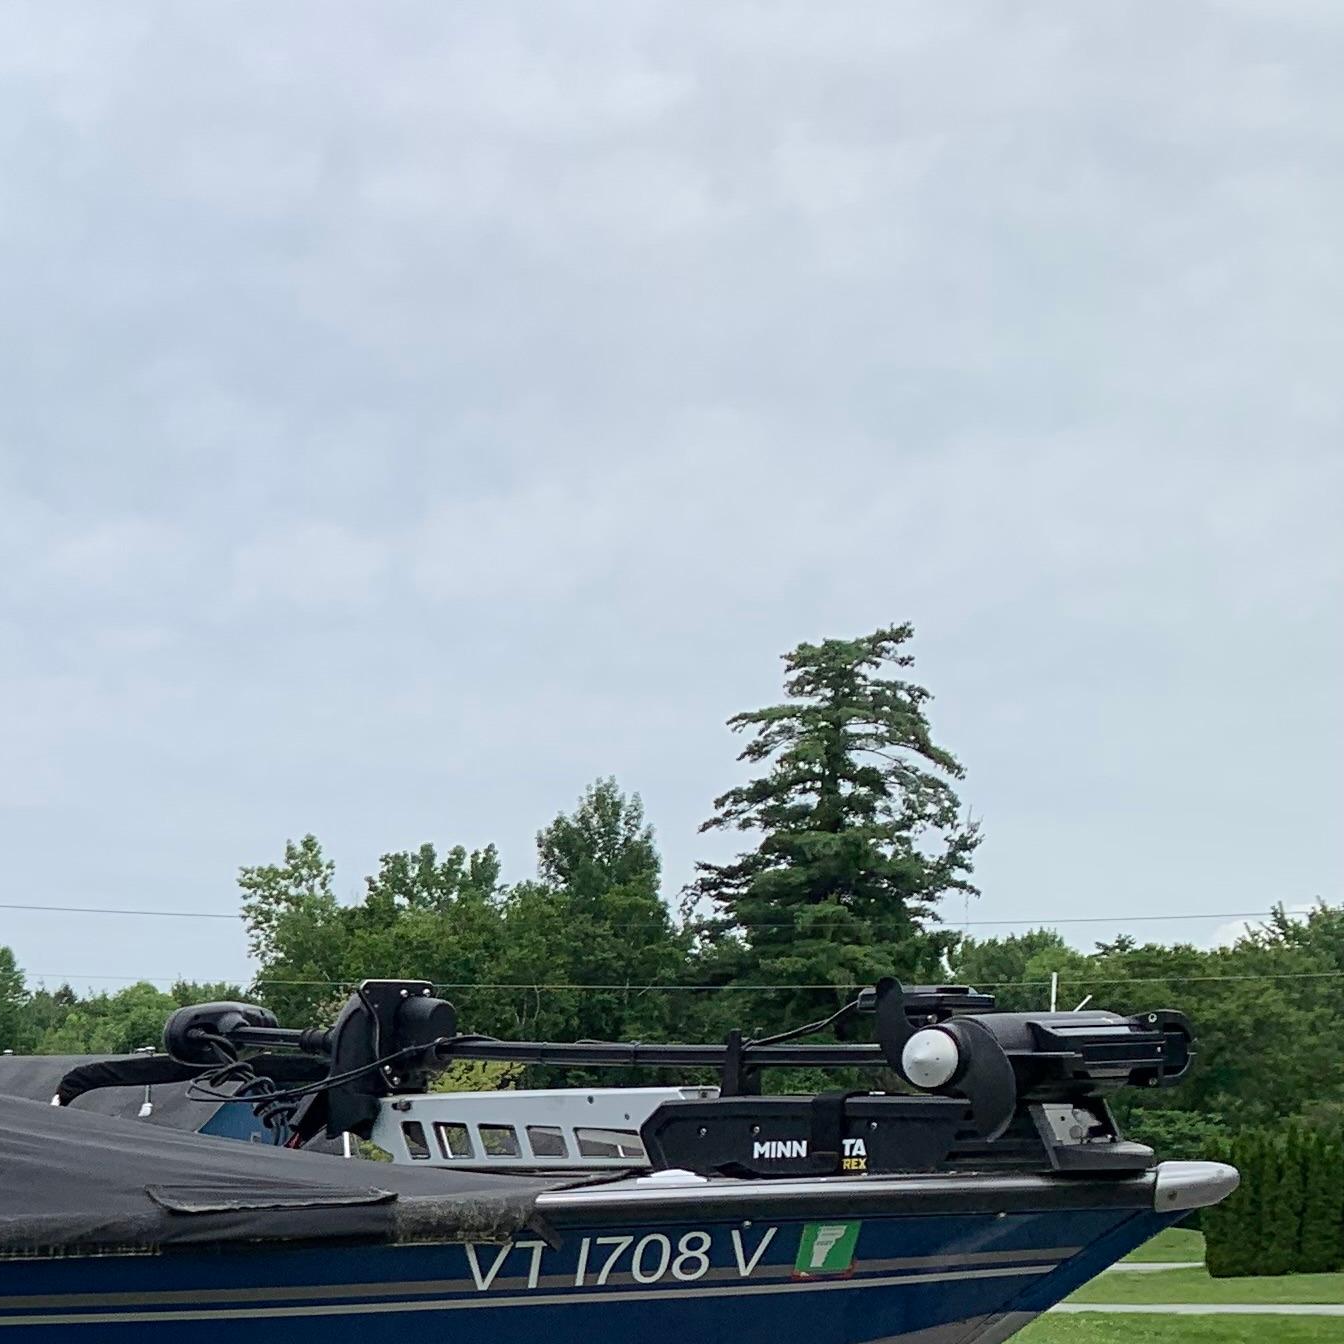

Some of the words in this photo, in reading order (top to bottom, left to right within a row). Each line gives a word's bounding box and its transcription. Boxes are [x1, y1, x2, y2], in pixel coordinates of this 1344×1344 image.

[753, 1140, 807, 1159] MINN
[842, 1138, 867, 1156] TA
[842, 1158, 867, 1170] REX
[465, 1240, 547, 1291] VT
[575, 1231, 711, 1286] 1708
[732, 1227, 778, 1277] V
